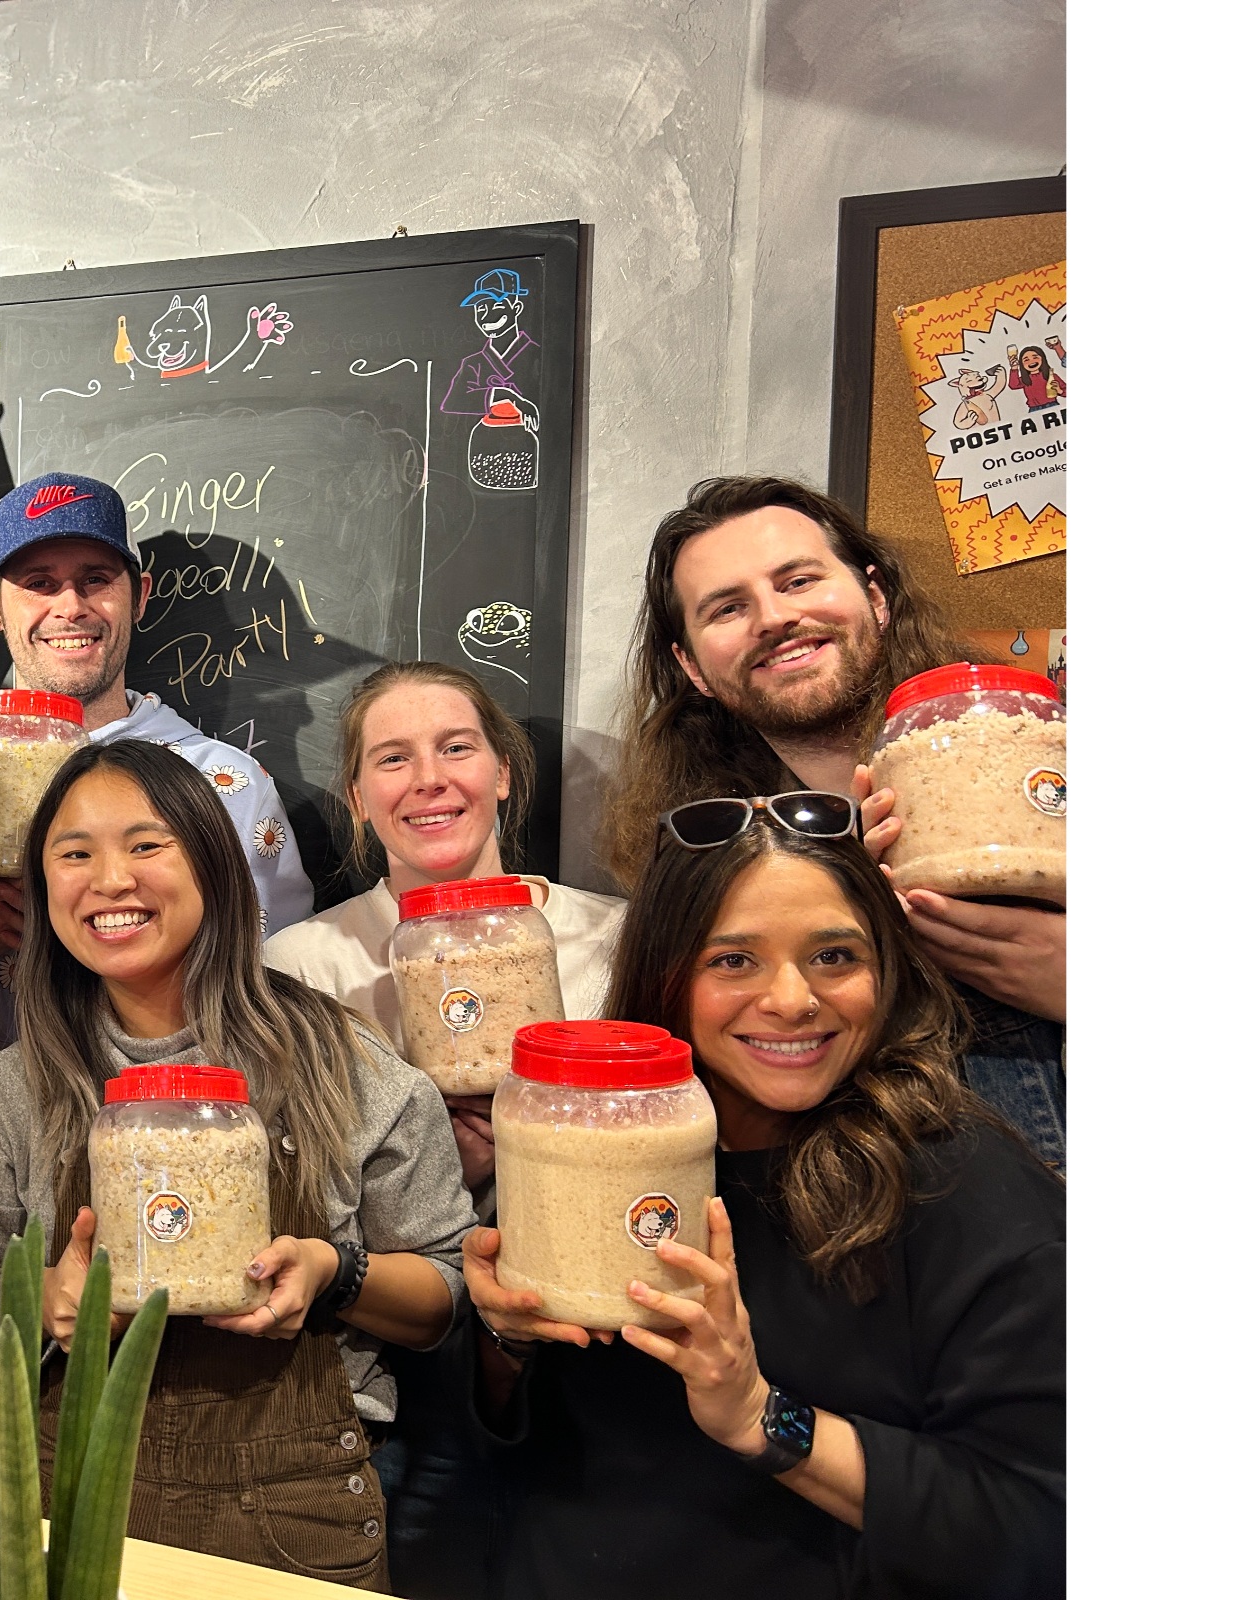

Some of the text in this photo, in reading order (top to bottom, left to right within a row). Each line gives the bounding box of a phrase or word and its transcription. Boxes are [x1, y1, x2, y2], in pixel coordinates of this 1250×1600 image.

[949, 423, 1013, 454] POST
[1020, 417, 1037, 436] A
[982, 457, 1007, 471] On
[983, 478, 1003, 490] Get
[1005, 477, 1012, 485] a
[1014, 472, 1037, 482] free
[33, 485, 76, 505] NIKE
[114, 453, 275, 549] Ginger
